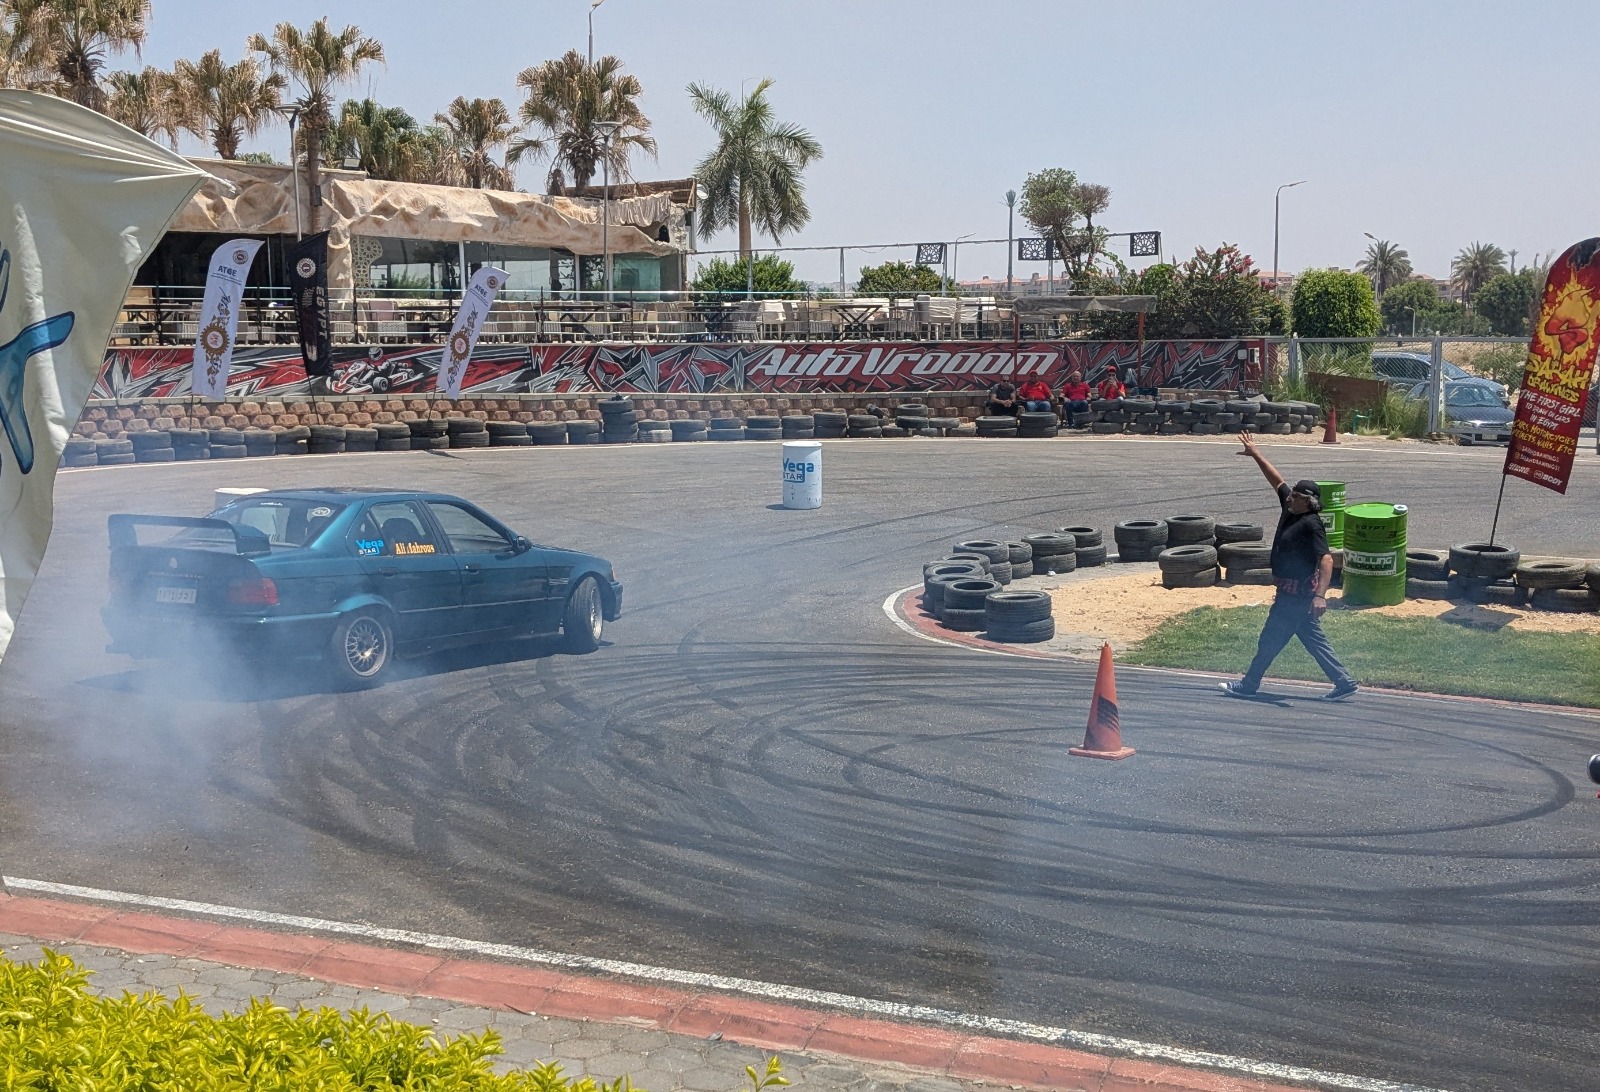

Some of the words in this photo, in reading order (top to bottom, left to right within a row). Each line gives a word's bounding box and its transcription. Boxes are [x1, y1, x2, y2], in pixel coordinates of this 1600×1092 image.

[316, 286, 328, 339] EGYPT
[1520, 389, 1539, 402] THE
[1537, 396, 1560, 410] FIRST
[1560, 404, 1581, 417] GIRL
[1526, 402, 1533, 410] TO
[1532, 405, 1549, 415] DRAW
[1555, 415, 1571, 423] CARS
[1537, 416, 1560, 430] EGYPT
[1556, 444, 1573, 455] ETC
[356, 539, 384, 552] Vega
[395, 542, 407, 554] Ali
